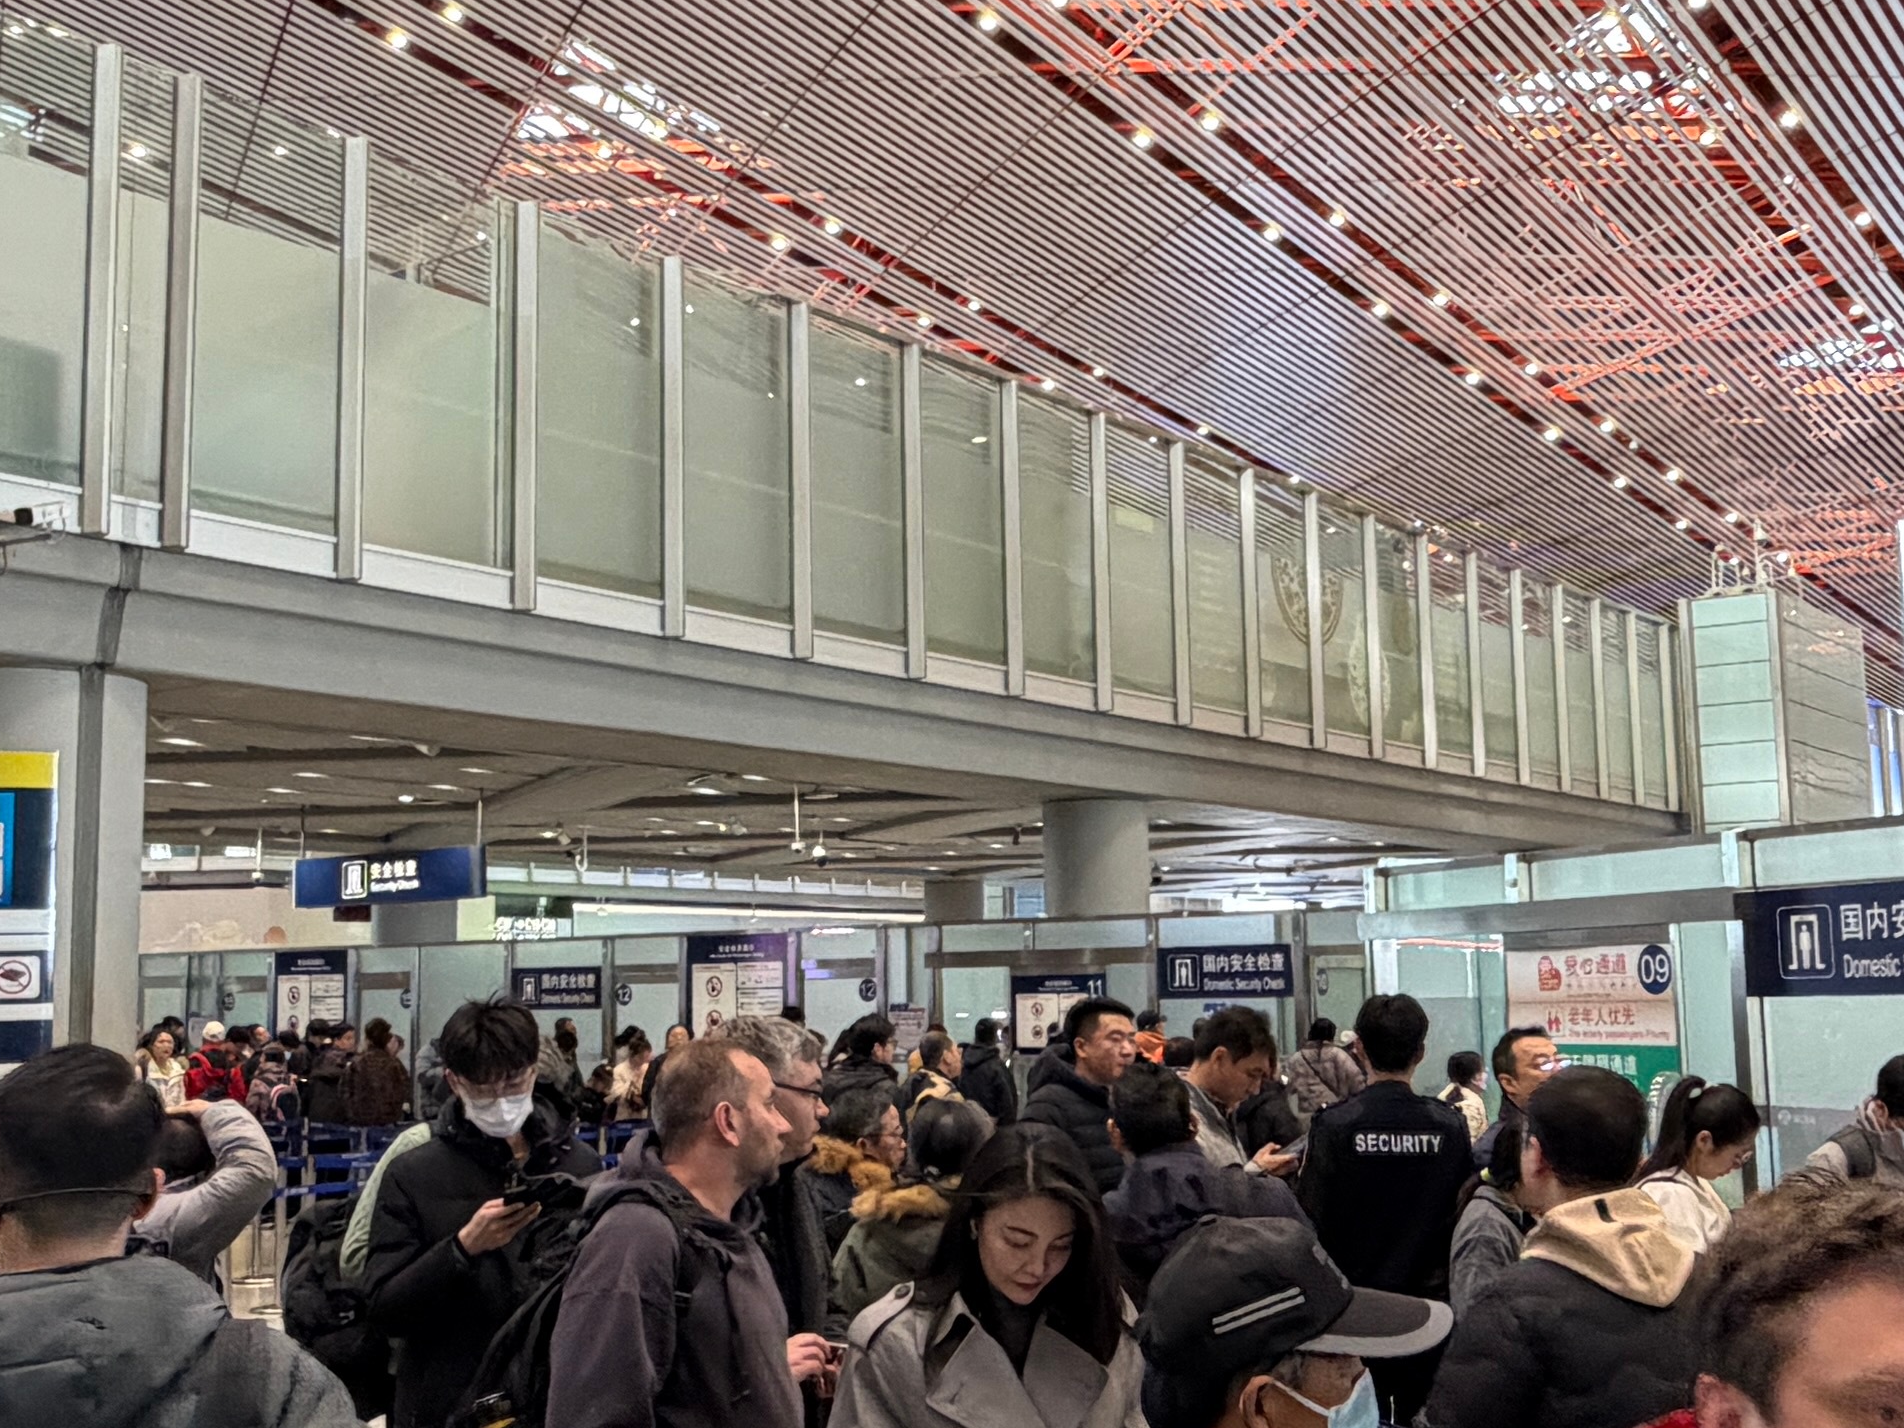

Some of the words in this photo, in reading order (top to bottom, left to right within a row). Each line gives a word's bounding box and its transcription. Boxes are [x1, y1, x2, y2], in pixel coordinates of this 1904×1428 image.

[370, 858, 418, 880] 安全检查
[1202, 952, 1285, 973] 国内安全检查
[1640, 953, 1670, 984] 09
[1843, 952, 1900, 979] Domestic
[617, 987, 631, 1002] 12
[860, 981, 876, 997] 12
[1087, 979, 1104, 999] 11
[1568, 1006, 1635, 1027] 老年人优先
[1355, 1133, 1441, 1153] SECURITY
